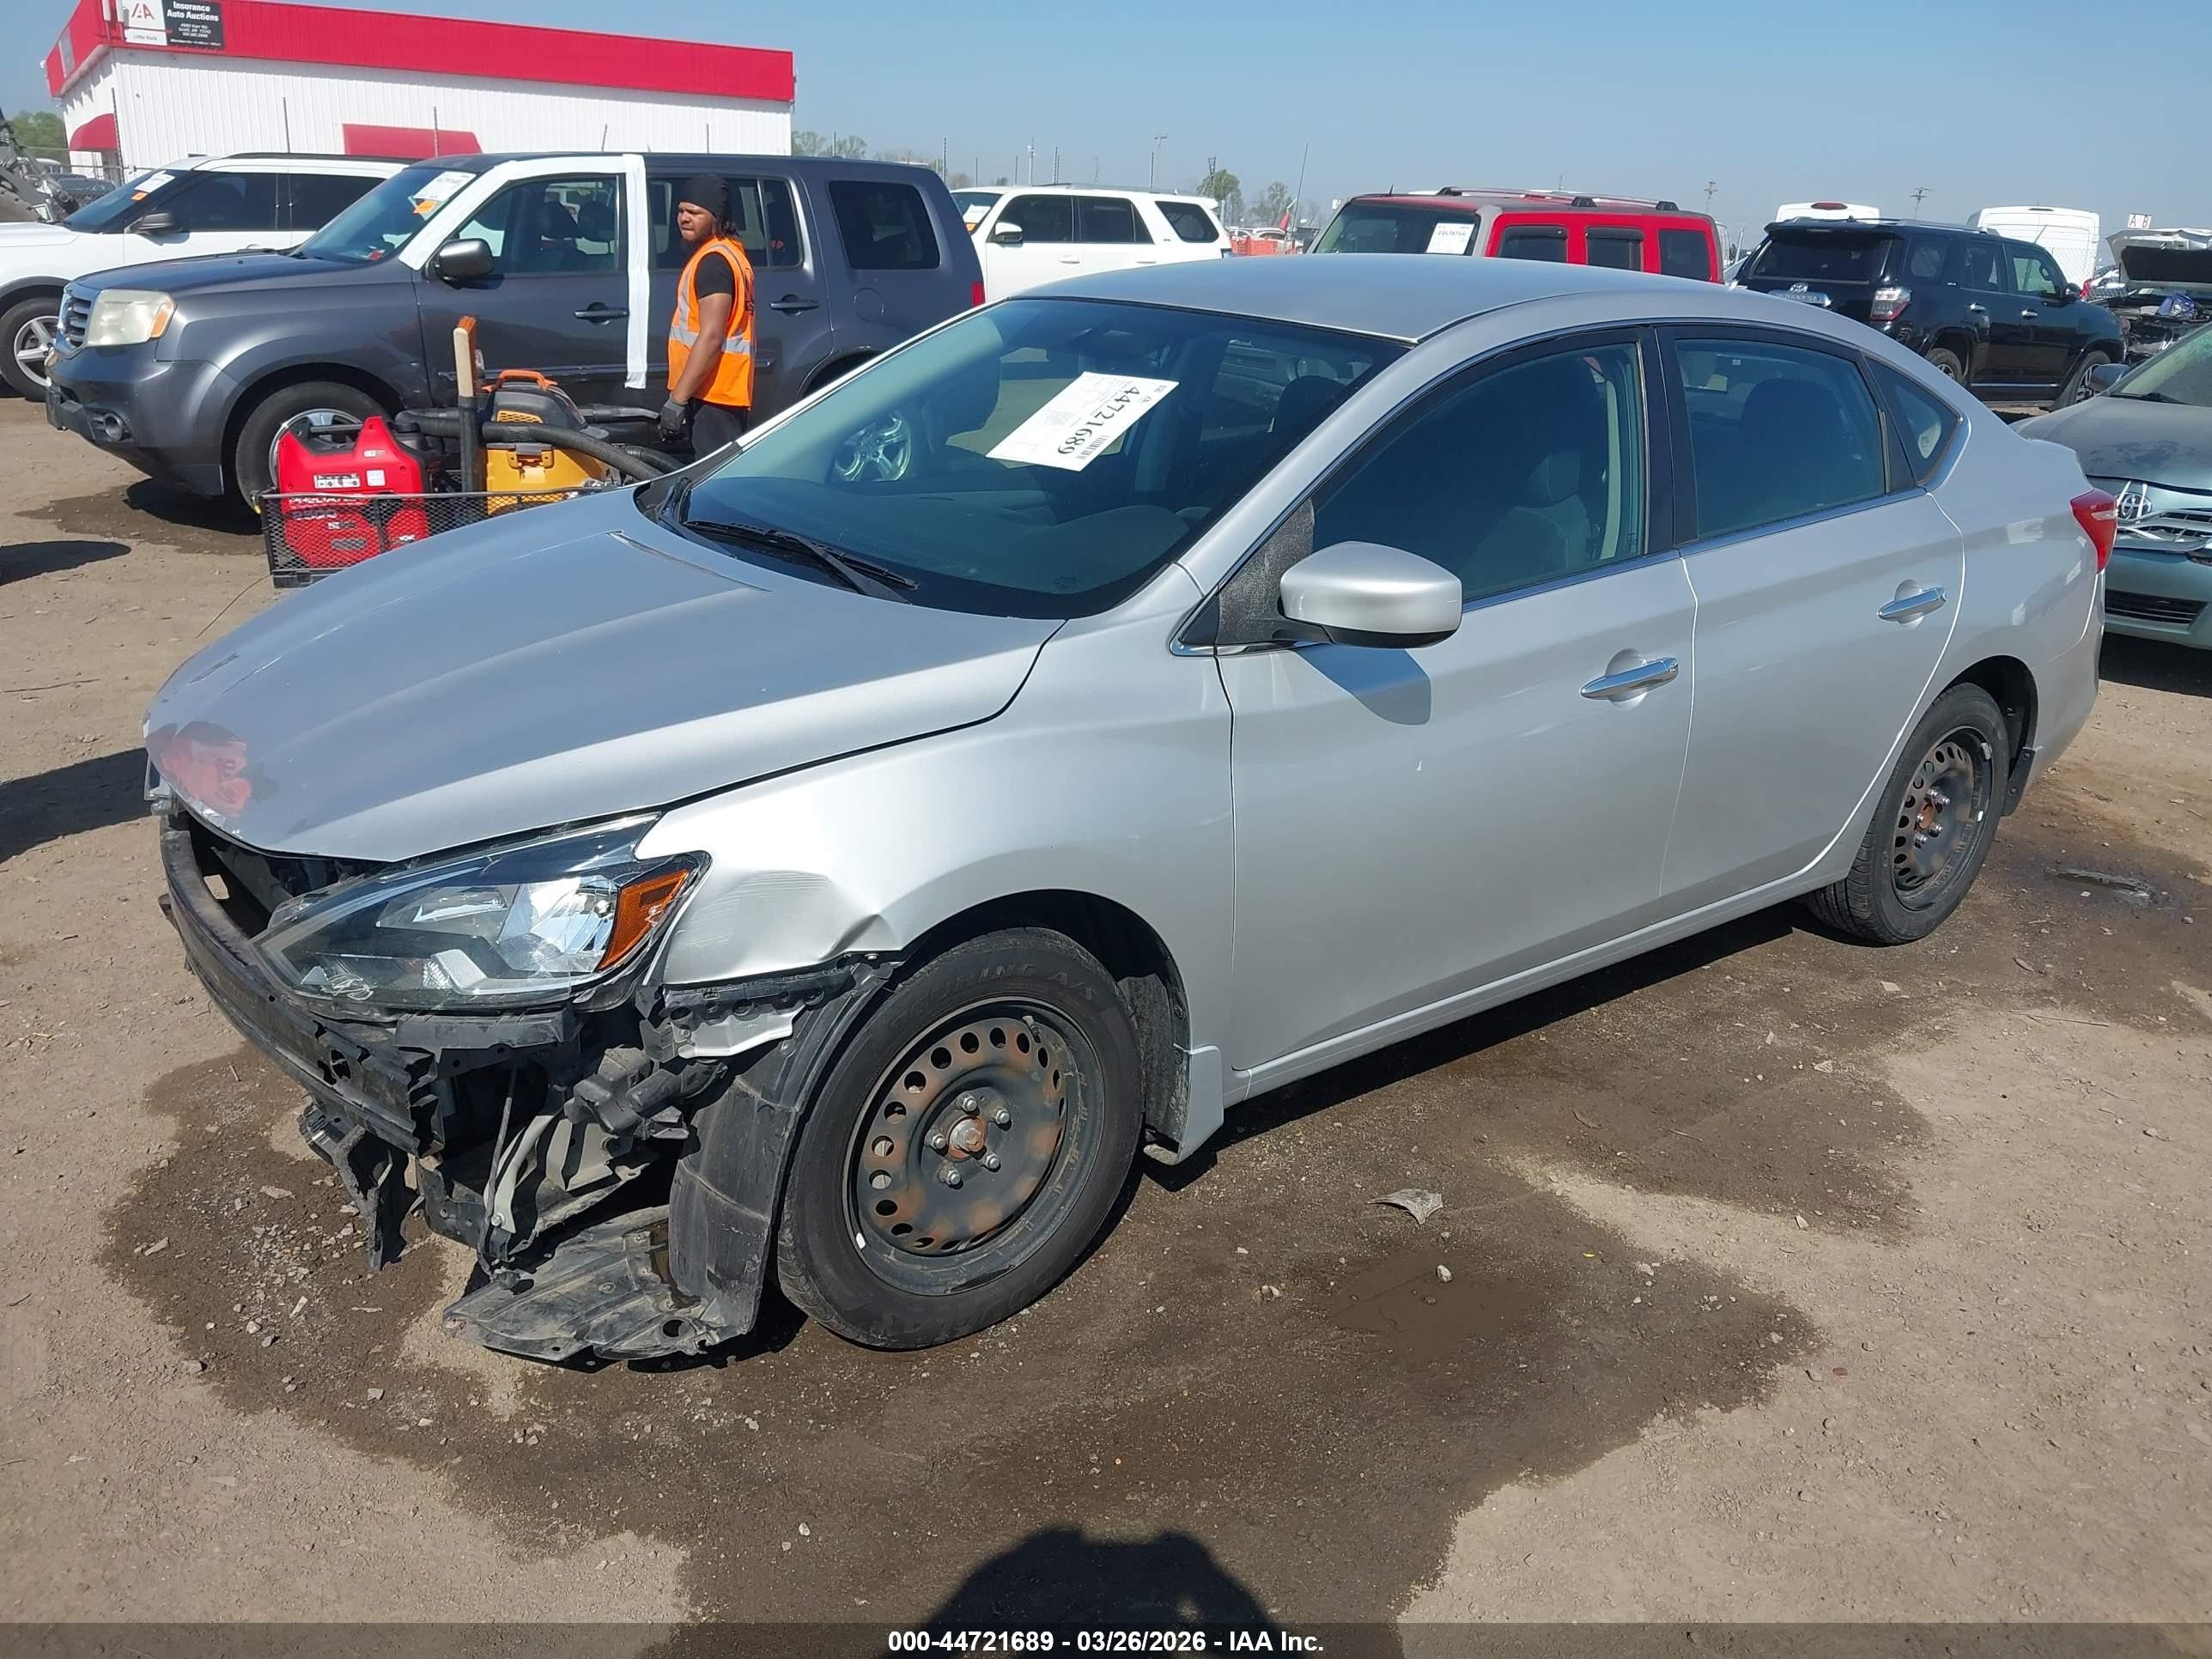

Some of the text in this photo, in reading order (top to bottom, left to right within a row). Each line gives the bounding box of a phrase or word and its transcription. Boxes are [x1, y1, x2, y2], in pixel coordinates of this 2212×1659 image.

[173, 1, 211, 12] Insurance
[167, 9, 219, 22] Auto Auctions
[1058, 386, 1140, 455] 44721689
